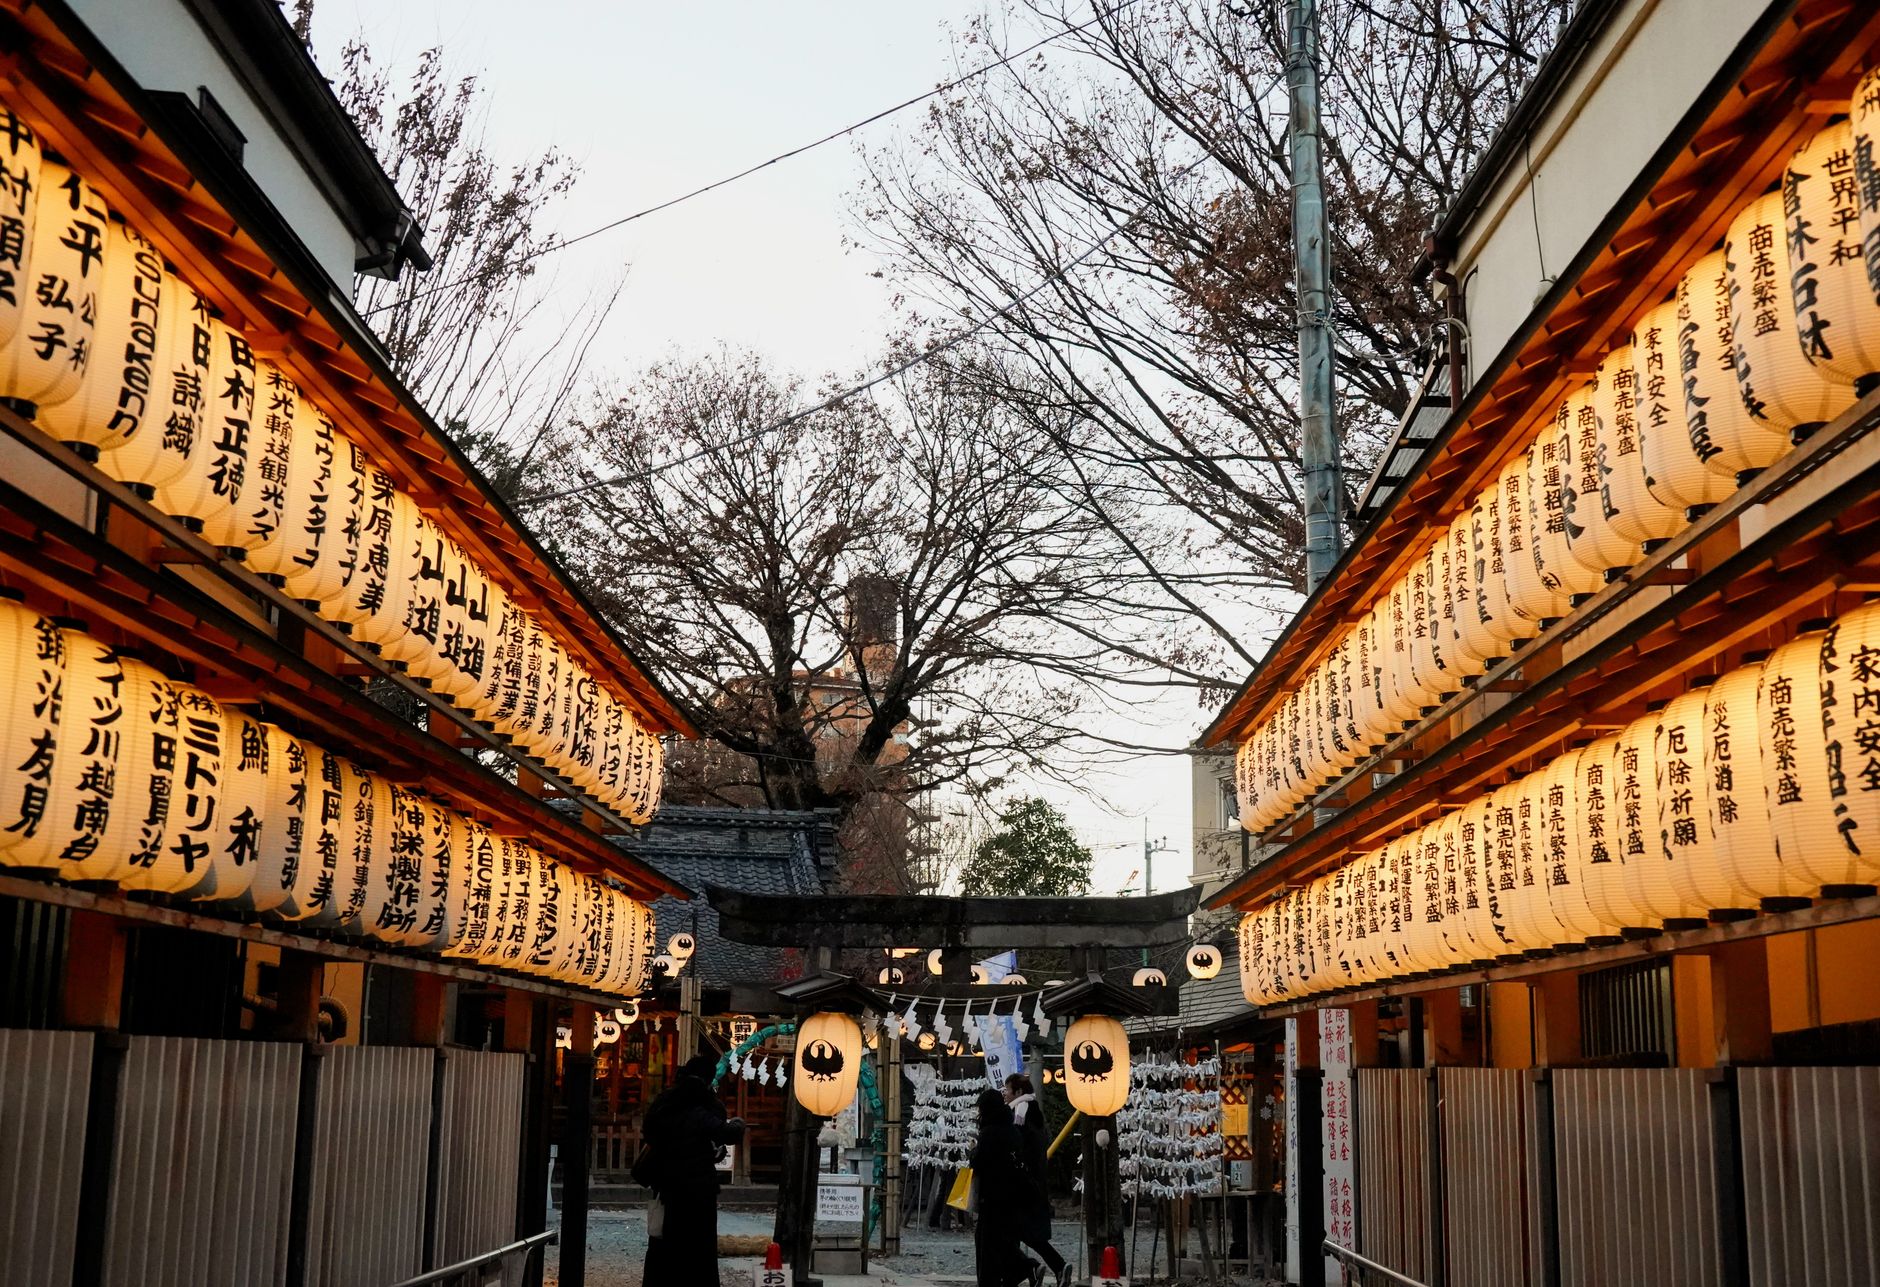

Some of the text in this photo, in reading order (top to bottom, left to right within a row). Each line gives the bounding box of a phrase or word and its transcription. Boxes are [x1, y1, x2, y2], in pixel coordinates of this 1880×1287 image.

[58, 172, 106, 279] 仁平
[1821, 148, 1863, 267] 世界平和
[28, 273, 74, 361] 弘子
[1713, 270, 1738, 372] 交通安全
[1748, 223, 1782, 339] 商売繁盛
[162, 363, 202, 460] 詩織
[207, 330, 256, 506] 田村正徳
[1612, 367, 1638, 457] 商売繁盛
[1643, 326, 1672, 429] 家内安全
[1542, 442, 1566, 536] 開運招福
[1577, 404, 1600, 496] 商売繁盛
[356, 469, 395, 616] 栗原恵美
[1505, 474, 1524, 554] 商売繁盛
[411, 518, 445, 645] (有山進
[439, 540, 468, 667] (有山進
[1412, 573, 1428, 640] 家内安全
[1453, 528, 1470, 603] 家内安全
[459, 557, 489, 683] (有山進
[1358, 627, 1371, 689] 商売繁盛
[1392, 592, 1405, 653] 良縁祈願
[511, 616, 543, 732] 三和設備工業(株
[1850, 644, 1880, 792] 家内安全
[59, 646, 125, 862] メイツ川越南台
[170, 690, 222, 874] (株)ミドリヤ
[1667, 725, 1698, 847] 厄除祈願
[1712, 701, 1739, 825] 災厄消除
[1769, 675, 1804, 806] 商売繁盛
[307, 752, 343, 911] 亀岡智美
[1496, 806, 1516, 891] 商売繁盛
[1518, 796, 1536, 887] 商売繁盛
[1548, 783, 1571, 887] 商売繁盛
[1587, 763, 1612, 864] 商売繁盛
[1622, 746, 1646, 856] 商売繁盛
[503, 840, 531, 959] 数野工務店(株
[1353, 872, 1367, 940] 商売繁盛
[1366, 864, 1380, 934] 商売繁盛
[1400, 850, 1413, 923] 社運隆昌
[1424, 841, 1442, 924] 商売繁盛
[1443, 831, 1460, 916] 災厄消除
[1462, 821, 1480, 910] 商売繁盛
[1326, 1081, 1337, 1160] 社運隆昌
[1338, 1081, 1350, 1160] 交通安全
[1328, 1177, 1341, 1245] 諸願成
